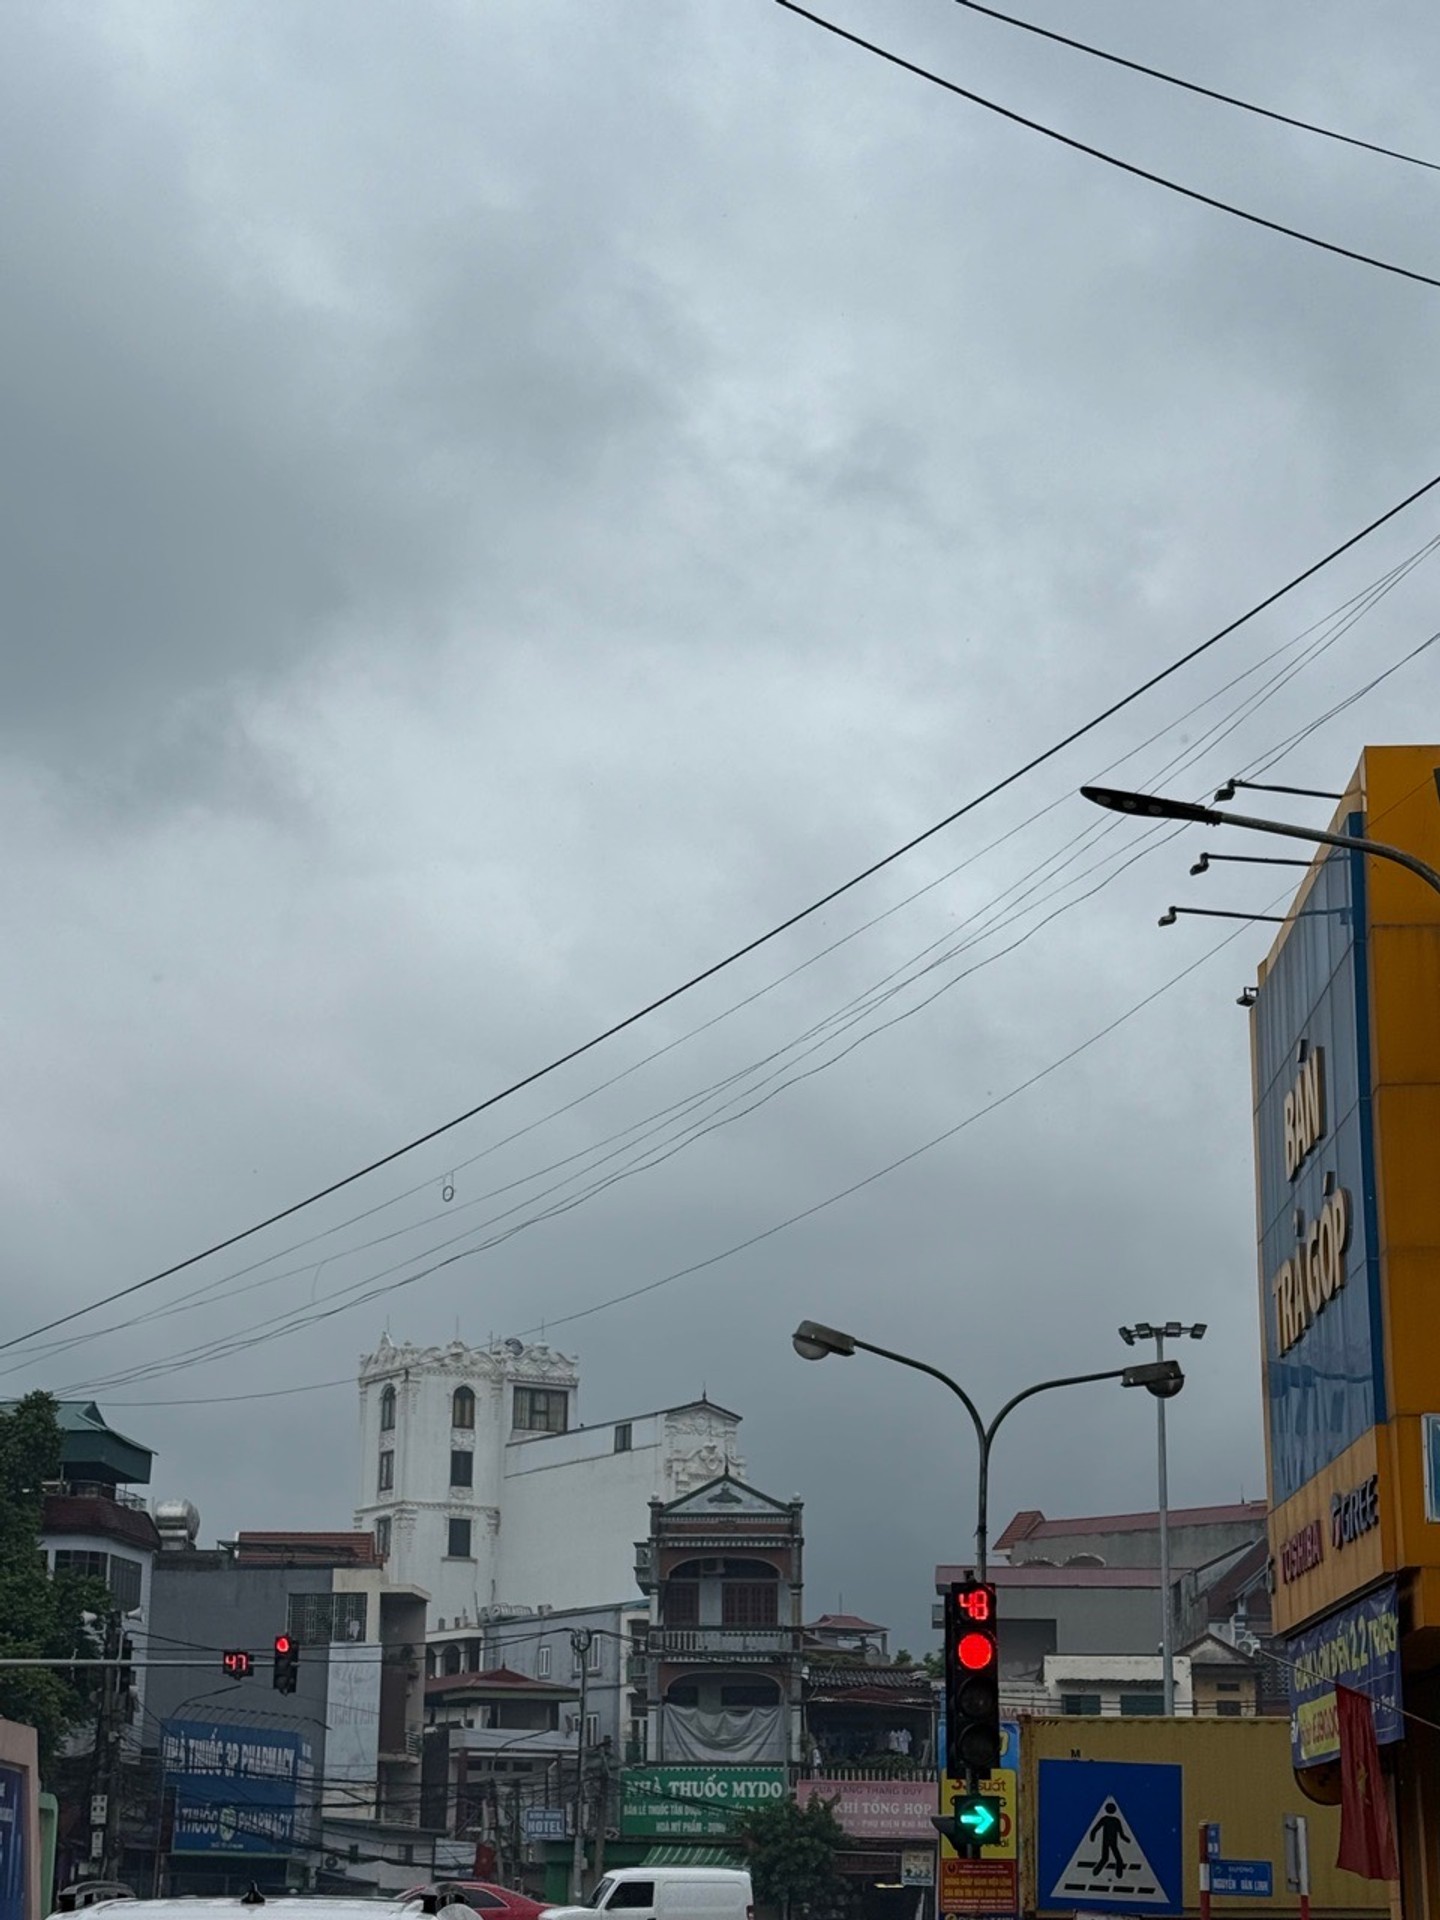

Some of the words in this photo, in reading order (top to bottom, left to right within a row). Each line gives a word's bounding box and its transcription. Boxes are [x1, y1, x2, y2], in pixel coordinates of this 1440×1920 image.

[1283, 1039, 1325, 1182] BÁN
[1305, 1171, 1351, 1316] GÓP
[1340, 1474, 1379, 1542] GREE
[1279, 1520, 1324, 1585] TOSHIBA
[225, 1653, 247, 1671] 47
[240, 1743, 296, 1782] PHARMACY
[626, 1776, 663, 1798] NHÀ
[667, 1774, 728, 1799] THUỐC
[731, 1780, 783, 1799] MYDO
[834, 1799, 858, 1814] KHÍ
[861, 1797, 900, 1815] TỔNG
[904, 1802, 932, 1818] HỢP
[238, 1811, 292, 1840] PHARMACY
[528, 1821, 562, 1833] HOTEL
